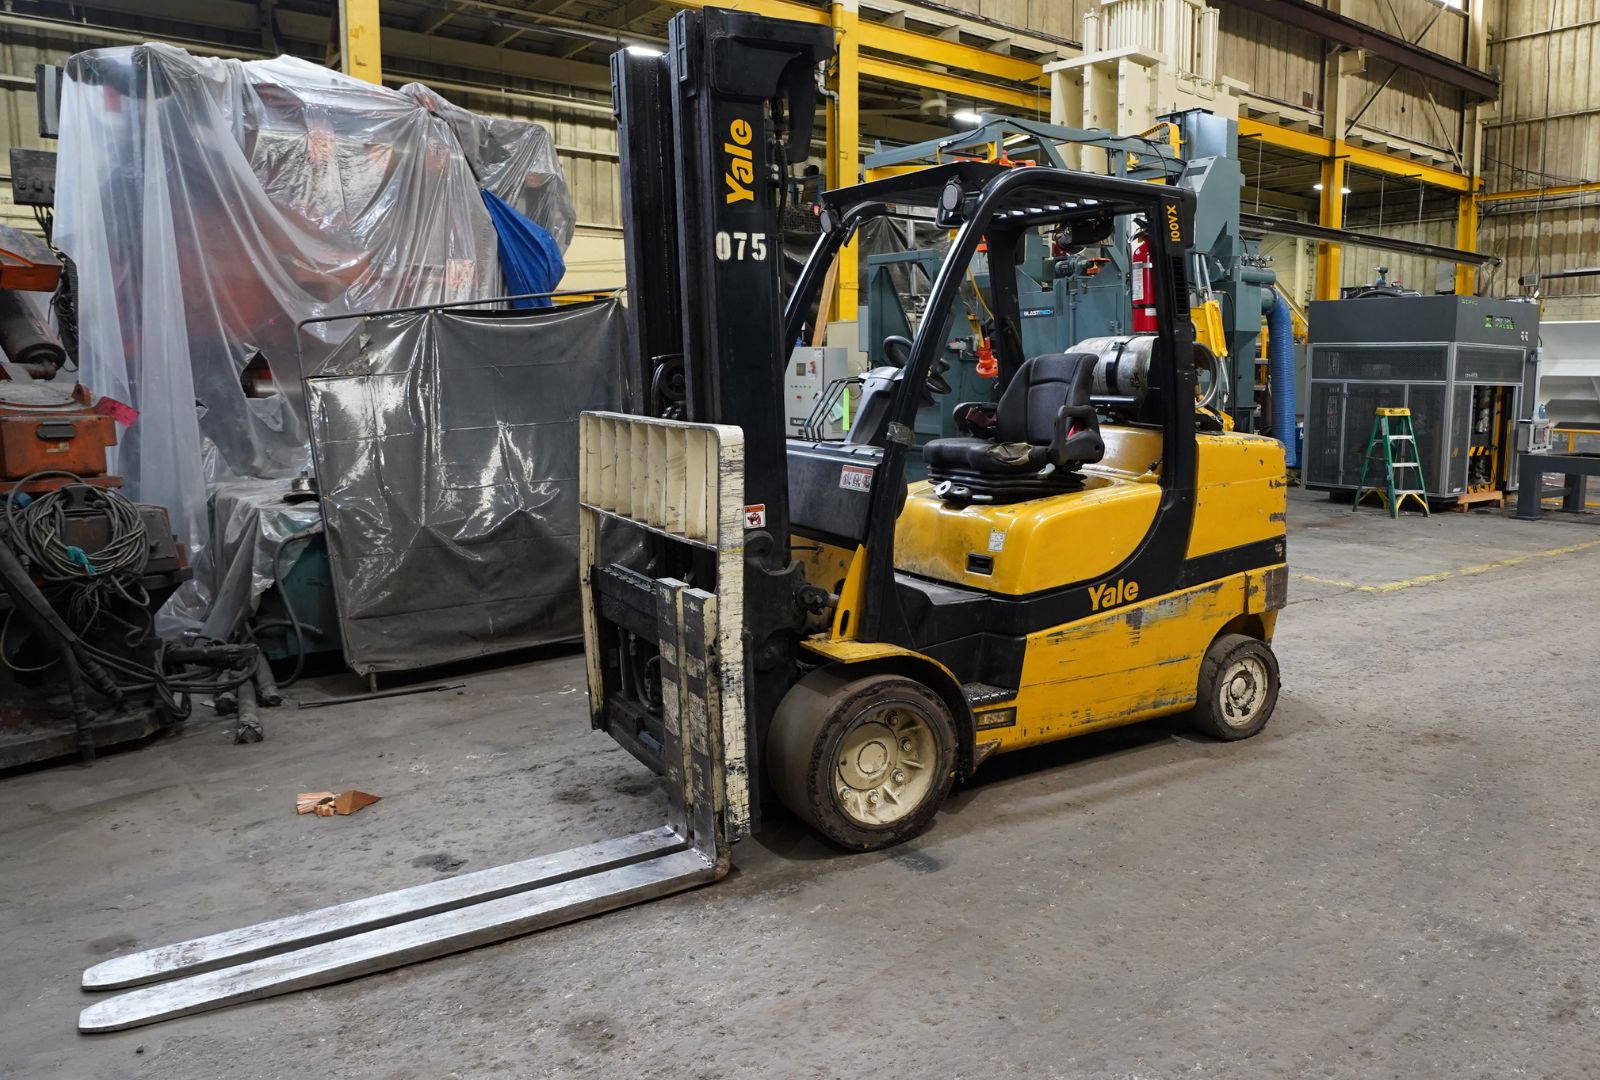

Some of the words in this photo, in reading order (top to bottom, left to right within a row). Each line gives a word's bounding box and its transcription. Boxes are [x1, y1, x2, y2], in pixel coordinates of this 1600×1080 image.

[724, 118, 754, 205] Yale
[1166, 205, 1181, 242] 100VX
[715, 231, 767, 261] 075
[1087, 577, 1139, 611] Yale
